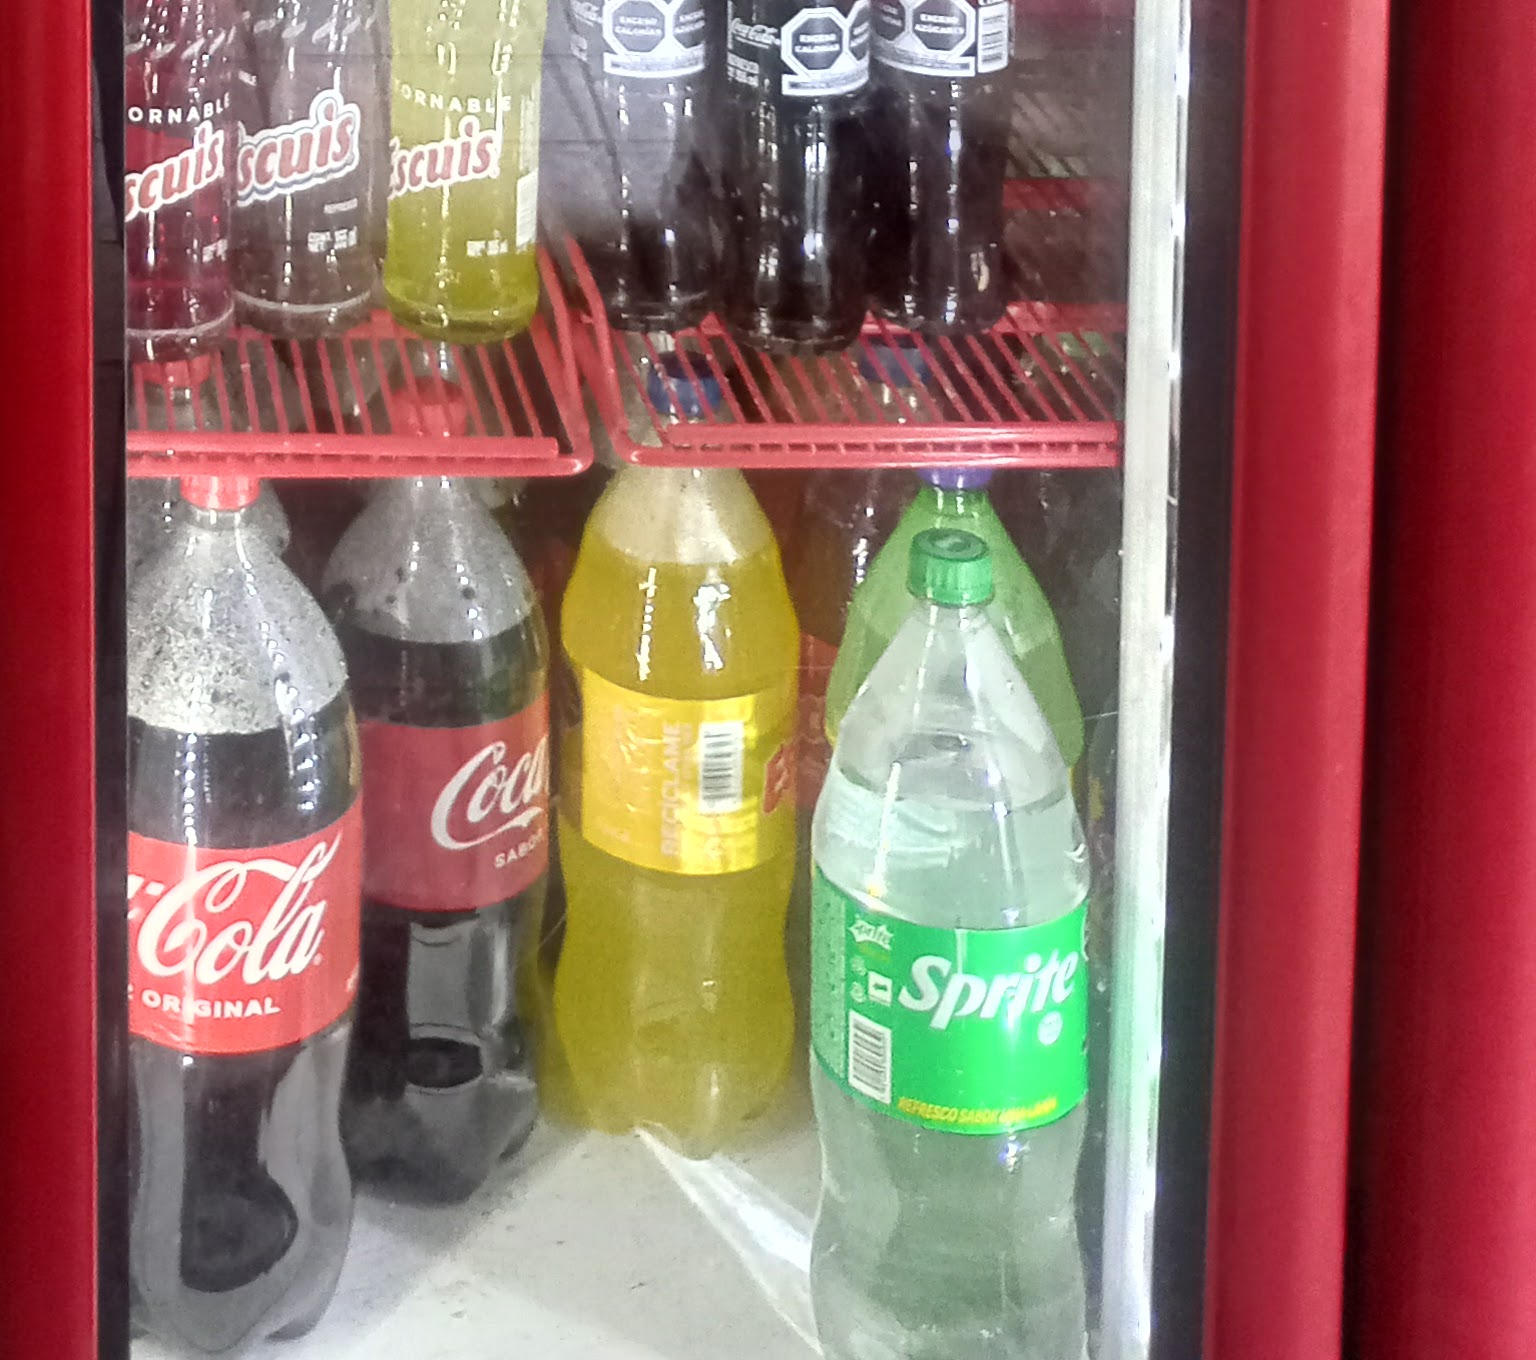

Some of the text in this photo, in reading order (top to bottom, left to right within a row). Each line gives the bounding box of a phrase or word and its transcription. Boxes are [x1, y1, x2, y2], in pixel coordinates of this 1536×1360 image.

[128, 91, 230, 124] ORNABLE
[400, 82, 512, 114] ORNABLE
[125, 120, 225, 221] scuis
[238, 92, 361, 204] scuis
[389, 116, 500, 199] scuis
[128, 830, 342, 984] -Cola
[142, 992, 281, 1018] ORIGINAL
[898, 948, 1079, 1031] Sprite
